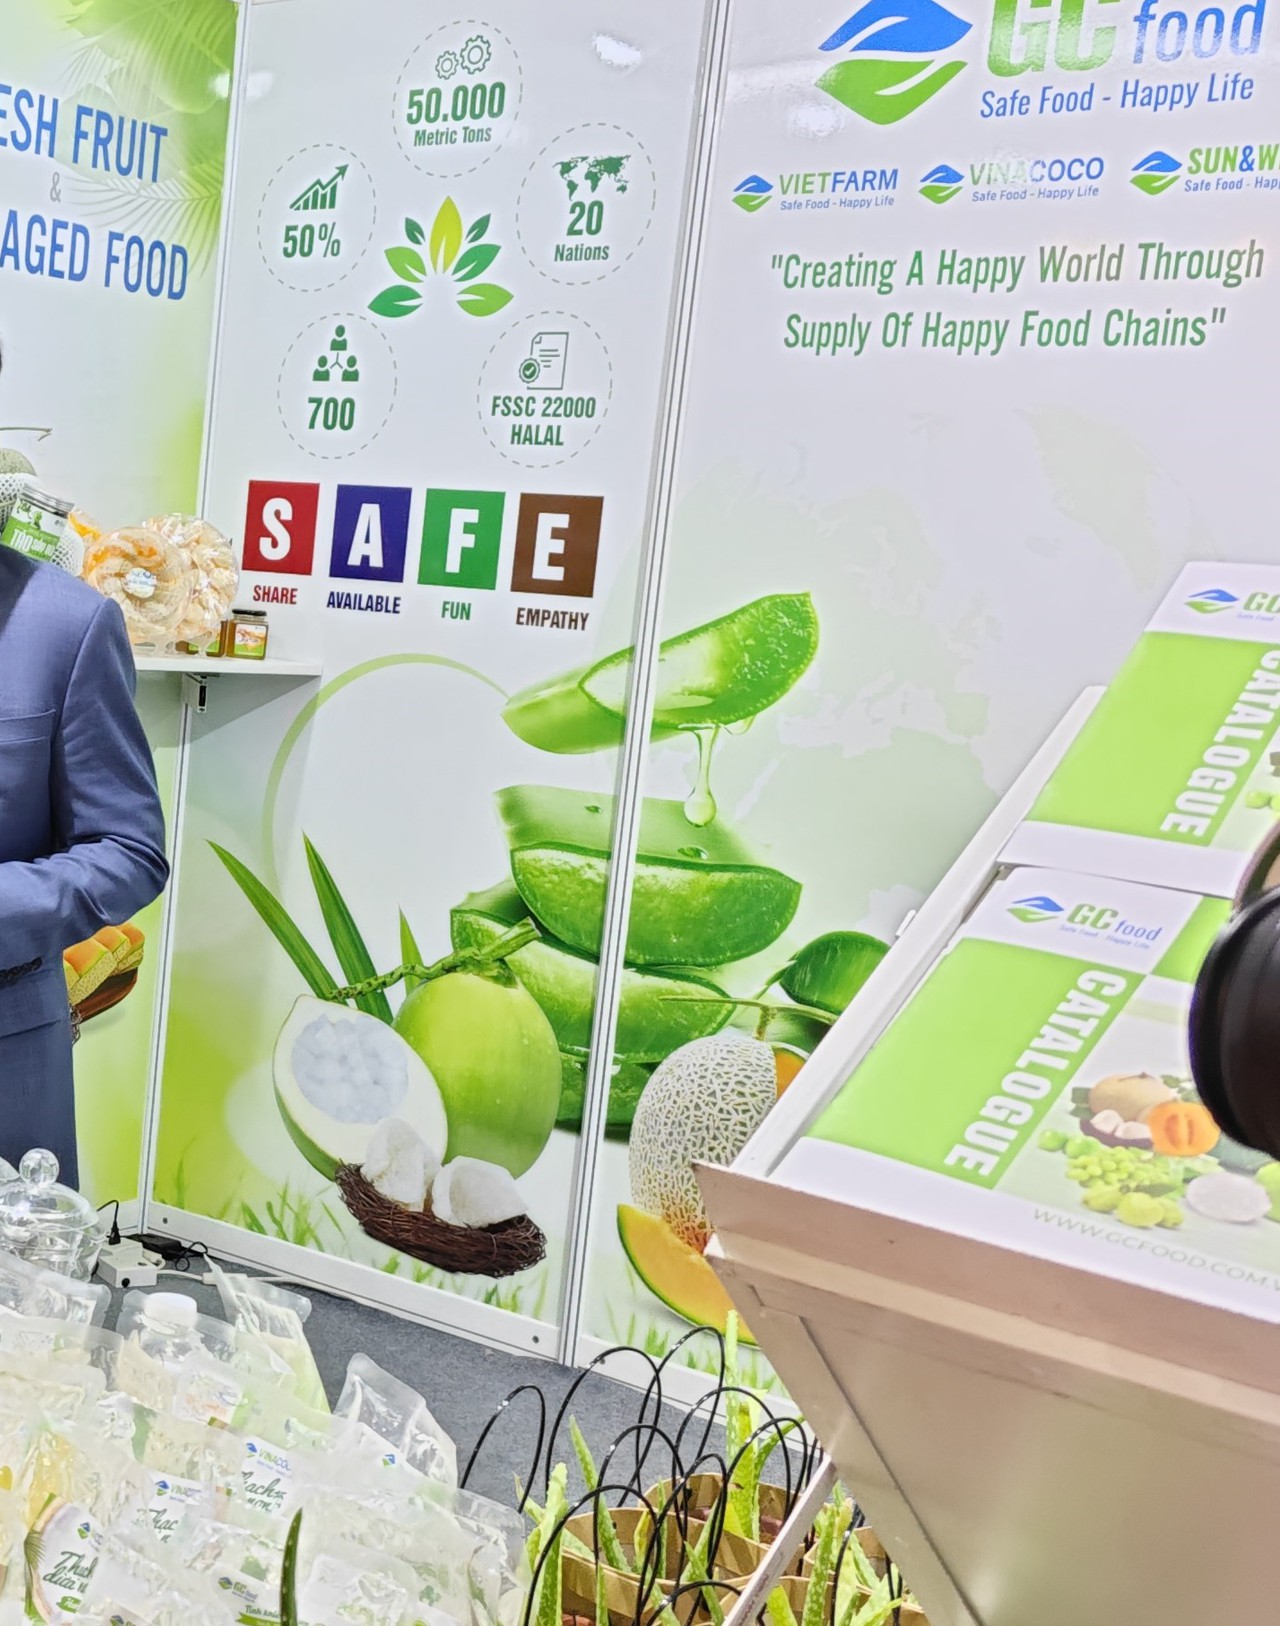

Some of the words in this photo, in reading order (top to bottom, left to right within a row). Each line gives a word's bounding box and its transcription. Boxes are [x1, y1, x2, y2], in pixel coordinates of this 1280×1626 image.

[987, 0, 1118, 78] GC
[1133, 0, 1267, 64] food
[406, 81, 506, 125] 50.000
[979, 88, 1031, 119] Safe
[1038, 83, 1094, 115] Food
[1120, 77, 1200, 114] Happy
[1206, 72, 1255, 102] Life
[72, 103, 168, 183] FRUIT
[414, 128, 458, 147] Metric
[462, 126, 492, 144] Tons
[49, 171, 62, 203] &
[778, 168, 899, 196] VIETFARM
[969, 157, 1105, 186] VINACOCO
[1185, 179, 1211, 193] Safe
[1215, 177, 1243, 190] Food
[780, 199, 803, 211] Safe
[805, 198, 830, 209] Food
[839, 196, 872, 210] Happy
[875, 195, 895, 207] Life
[972, 190, 997, 202] Safe
[999, 189, 1027, 201] Food
[1037, 187, 1074, 201] Happy
[1077, 186, 1100, 198] Life
[566, 200, 604, 237] 20
[282, 222, 341, 258] 50%
[554, 243, 610, 263] Nations
[105, 231, 188, 301] FOOD
[771, 250, 897, 296] "Creating
[906, 250, 924, 287] A
[936, 247, 1026, 294] Happy
[1039, 242, 1125, 285] World
[1137, 239, 1265, 289] Through
[783, 312, 871, 357] Supply
[881, 311, 913, 348] Of
[921, 310, 1010, 356] Happy
[1020, 309, 1091, 348] Food
[1102, 307, 1226, 348] Chains"
[308, 396, 356, 431] 700
[491, 395, 537, 417] FSSC
[541, 396, 596, 419] 22000
[510, 424, 564, 446] HALAL
[259, 497, 293, 561] S
[347, 503, 384, 568] A
[445, 508, 479, 573] F
[531, 512, 570, 581] E
[253, 585, 298, 605] SHARE
[327, 591, 401, 614] AVAILABLE
[441, 601, 471, 621] FUN
[516, 607, 589, 631] EMPATHY
[1067, 903, 1119, 929] GC
[1114, 919, 1163, 941] food
[944, 969, 1128, 1177] CATALOGUE
